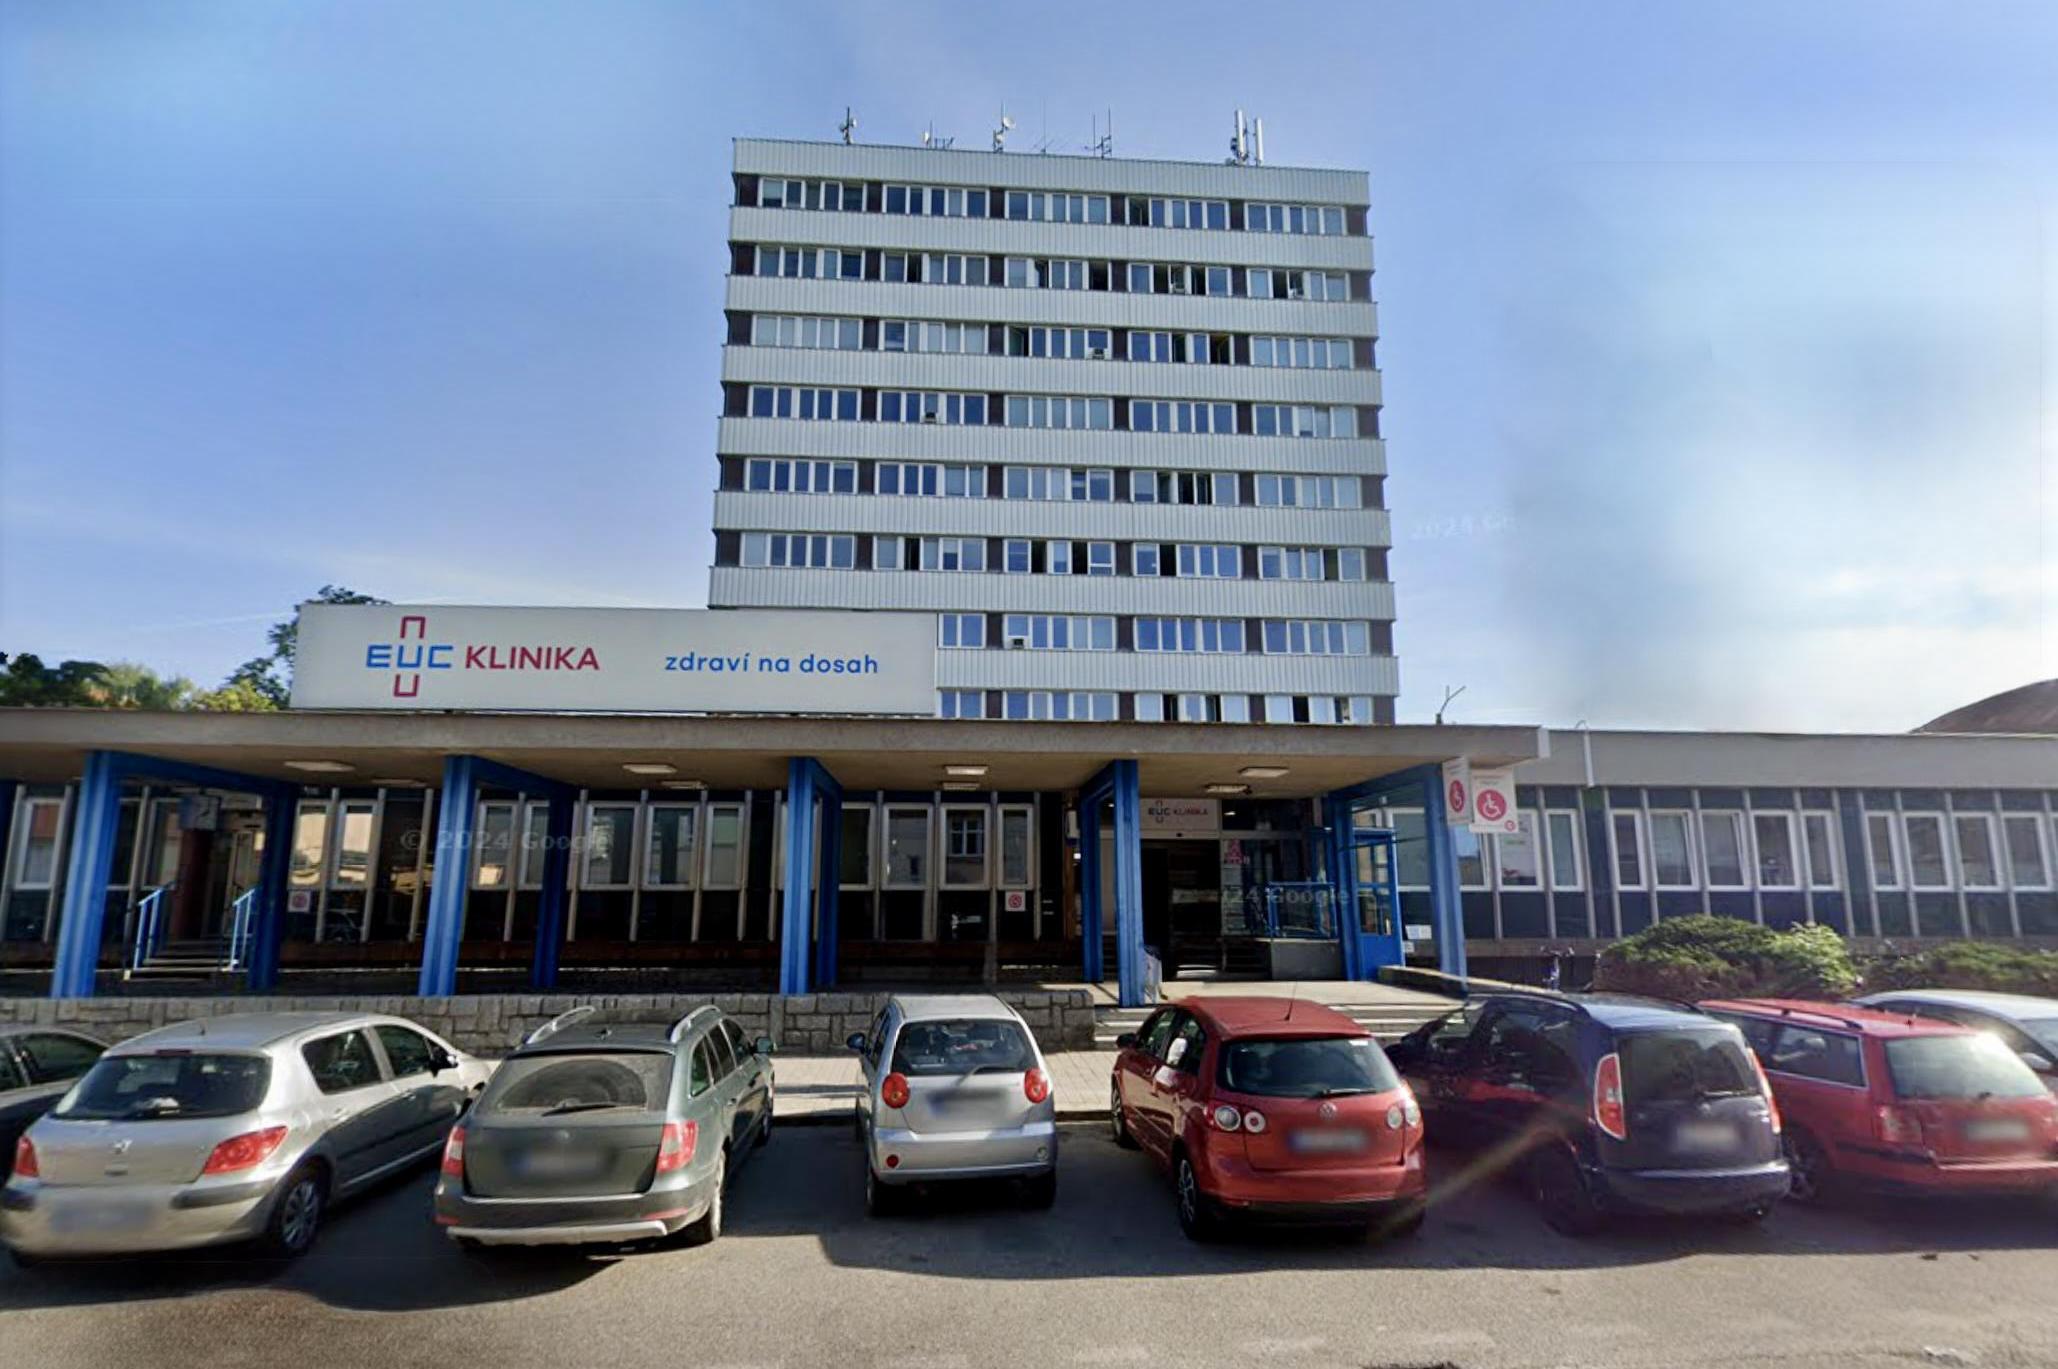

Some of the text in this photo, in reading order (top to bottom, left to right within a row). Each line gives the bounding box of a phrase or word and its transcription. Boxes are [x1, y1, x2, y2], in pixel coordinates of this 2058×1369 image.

[365, 644, 601, 671] EUC KLINIKA
[665, 652, 879, 673] zdraví na dosah
